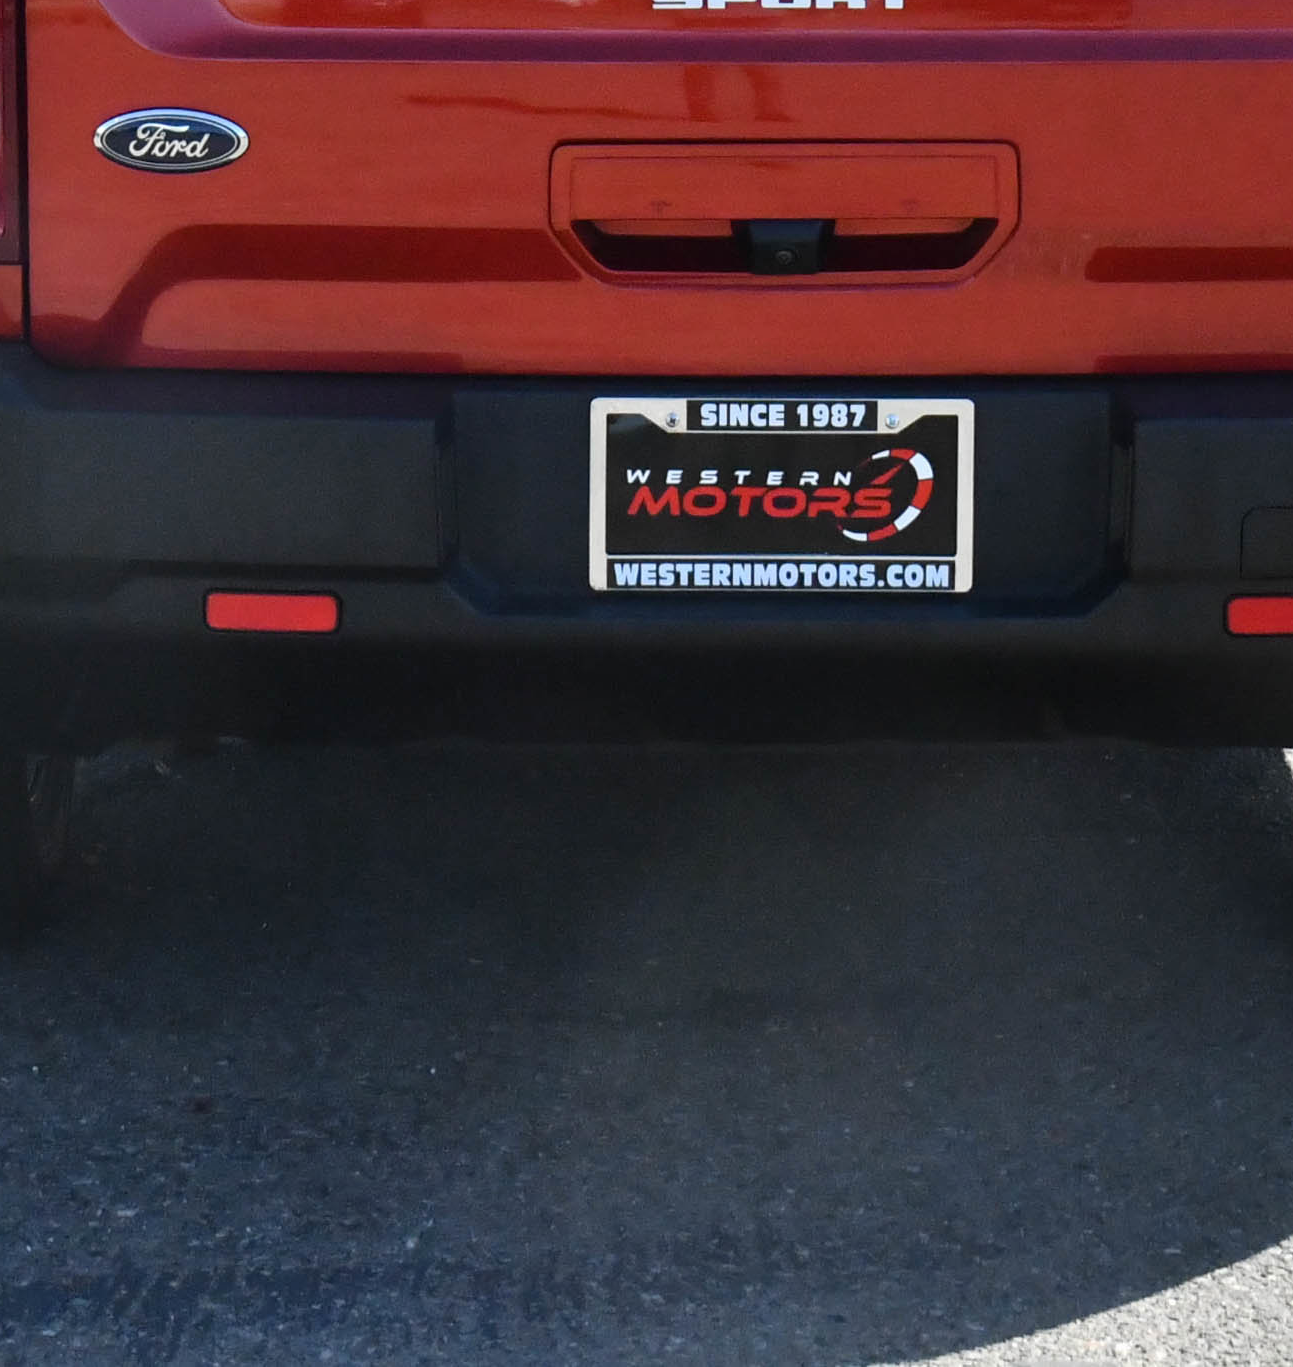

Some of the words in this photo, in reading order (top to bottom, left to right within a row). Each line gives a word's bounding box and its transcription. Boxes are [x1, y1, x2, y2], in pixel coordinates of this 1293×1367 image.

[128, 122, 211, 158] Ford
[700, 403, 785, 427] SINCE
[796, 404, 866, 428] 1987
[626, 469, 853, 486] WESTERN
[627, 485, 893, 519] MOTORS
[614, 562, 950, 588] WESTERNMOTORS.COM
